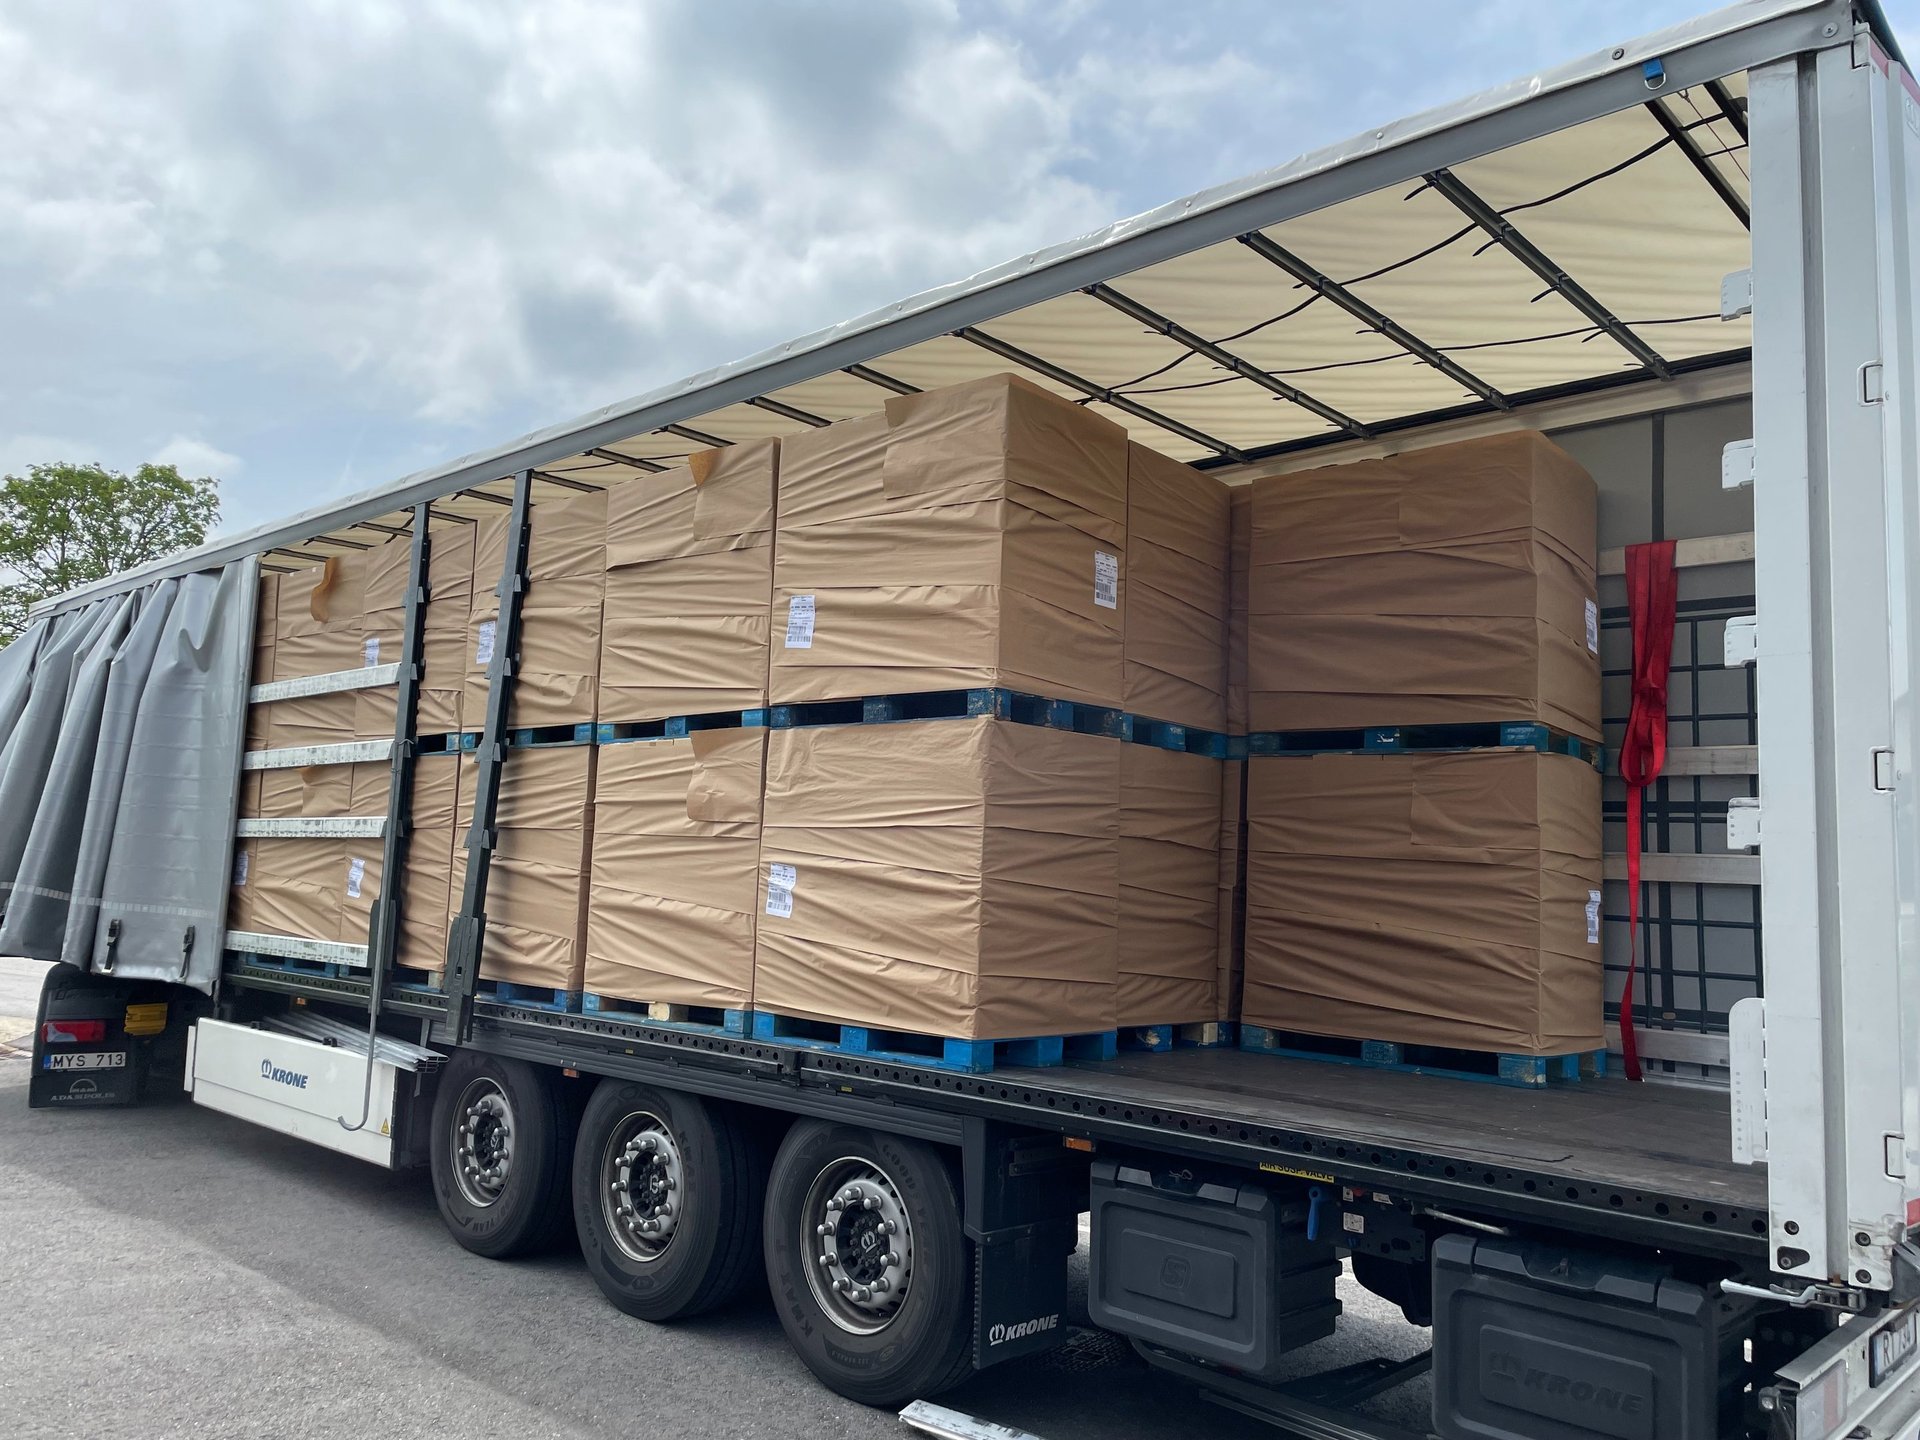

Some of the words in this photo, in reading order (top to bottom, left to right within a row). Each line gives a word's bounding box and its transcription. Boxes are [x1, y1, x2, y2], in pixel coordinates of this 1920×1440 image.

[53, 1055, 85, 1067] MYS
[96, 1054, 123, 1066] 713
[272, 1067, 309, 1089] KRONE
[1304, 1170, 1333, 1181] VALVE
[1005, 1314, 1059, 1341] KRONE
[1523, 1367, 1645, 1415] KRONE
